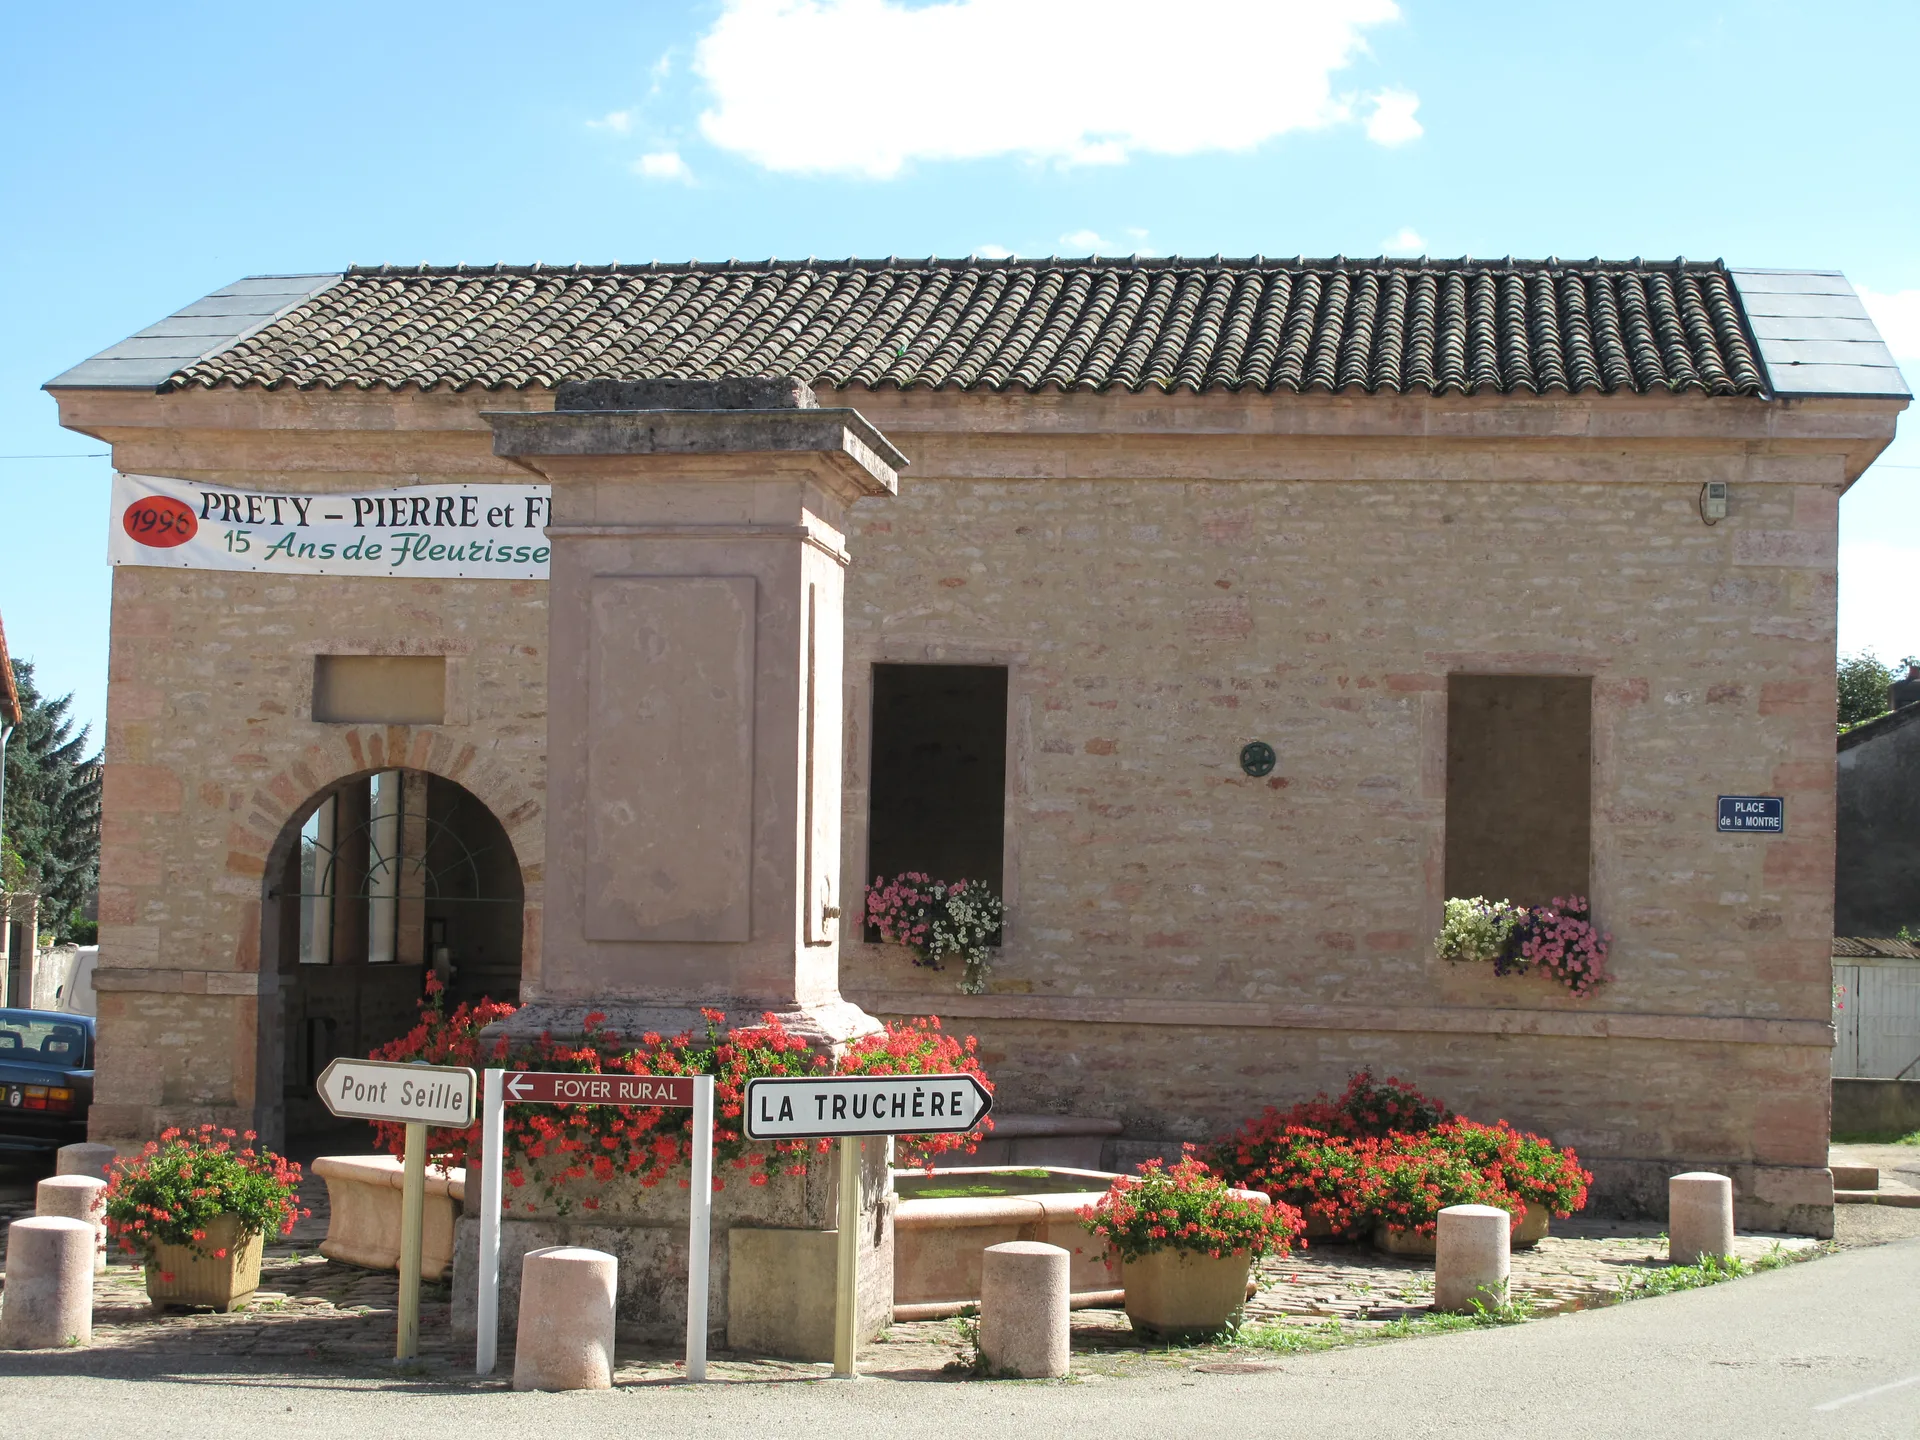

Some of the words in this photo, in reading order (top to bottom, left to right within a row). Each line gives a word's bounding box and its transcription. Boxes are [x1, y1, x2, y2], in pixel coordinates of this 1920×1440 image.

[199, 492, 313, 527] PRETY
[352, 496, 479, 528] PIERRE
[487, 503, 514, 528] et
[224, 530, 252, 553] 15
[264, 531, 336, 561] Ans
[342, 535, 383, 561] de
[390, 532, 550, 567] Fleurisse
[1720, 816, 1731, 826] de
[1735, 816, 1742, 826] la
[1745, 816, 1779, 827] MONTRE
[1735, 802, 1765, 813] PLACE
[341, 1075, 387, 1104] Pont
[400, 1079, 463, 1111] Seille
[554, 1079, 611, 1099] FOYER
[619, 1081, 678, 1100] RURAL
[761, 1096, 794, 1122] LA
[815, 1086, 963, 1120] TRUCHÈRE
